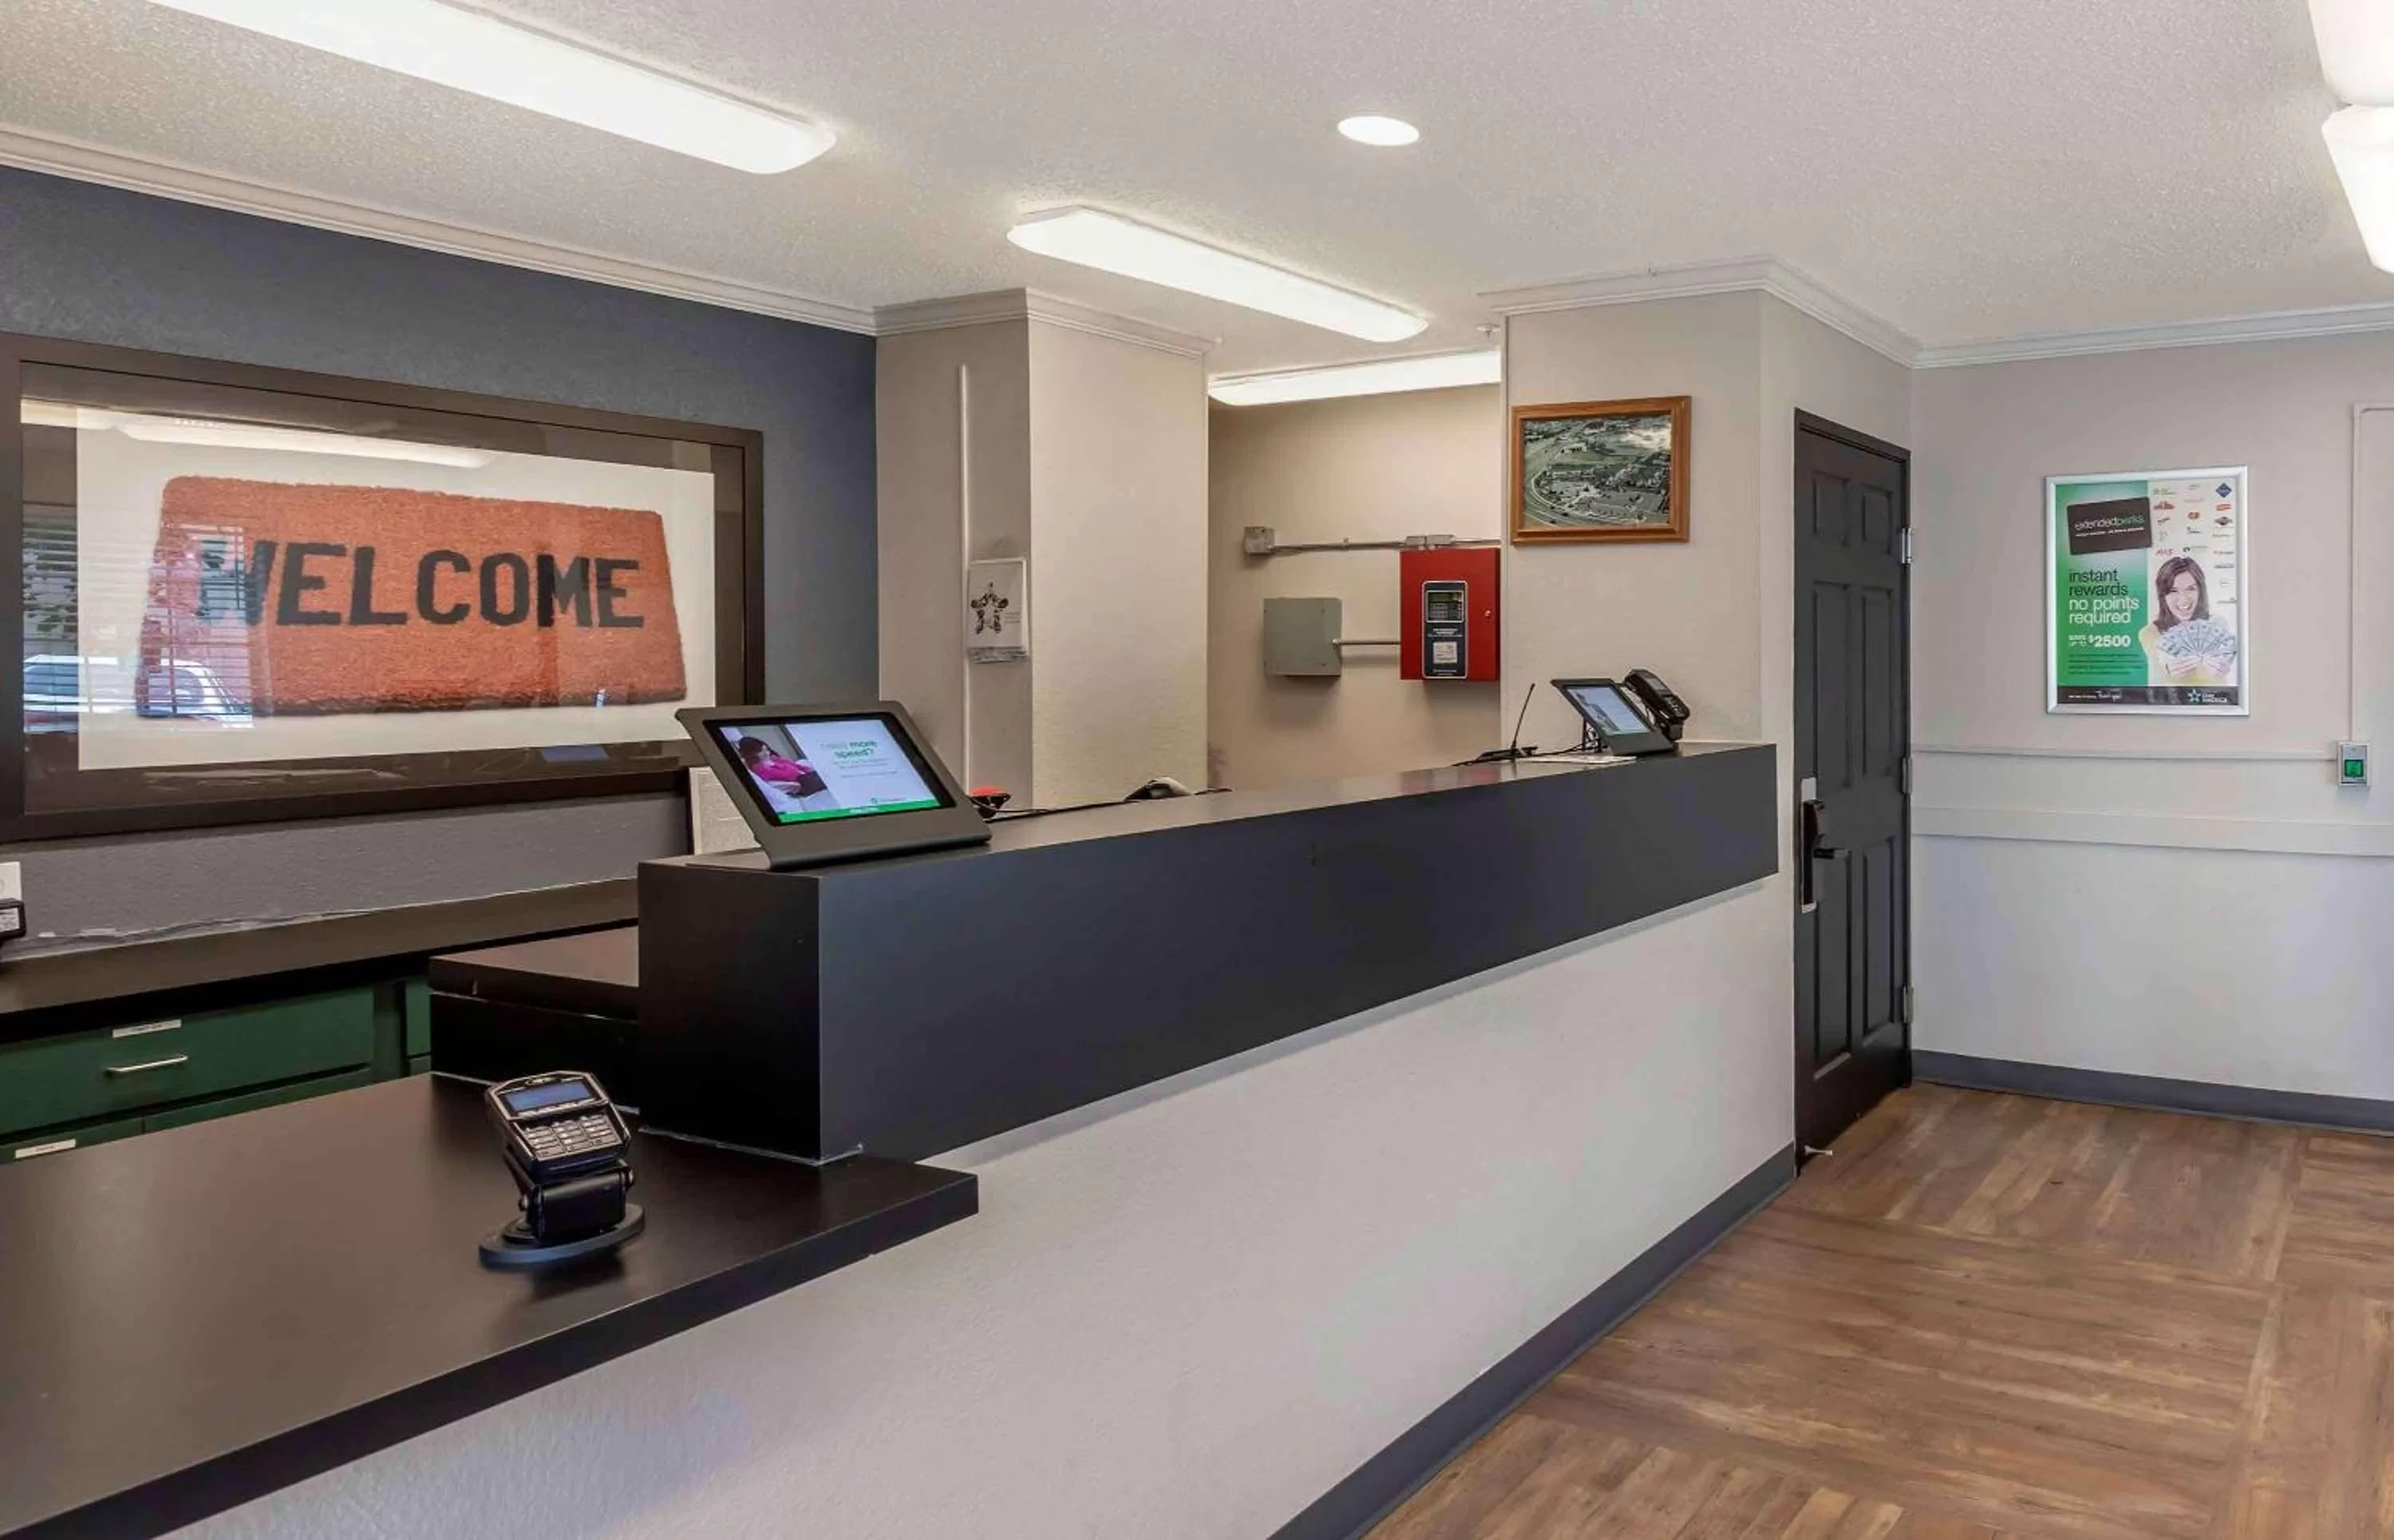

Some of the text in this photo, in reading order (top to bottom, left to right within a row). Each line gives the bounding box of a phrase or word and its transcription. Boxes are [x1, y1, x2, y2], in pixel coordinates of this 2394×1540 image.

[2069, 568, 2119, 582] instant
[197, 539, 644, 627] WELCOME
[2069, 582, 2128, 597] rewards
[2069, 596, 2139, 614] no points
[2069, 610, 2131, 626] required
[2088, 634, 2131, 647] $2500
